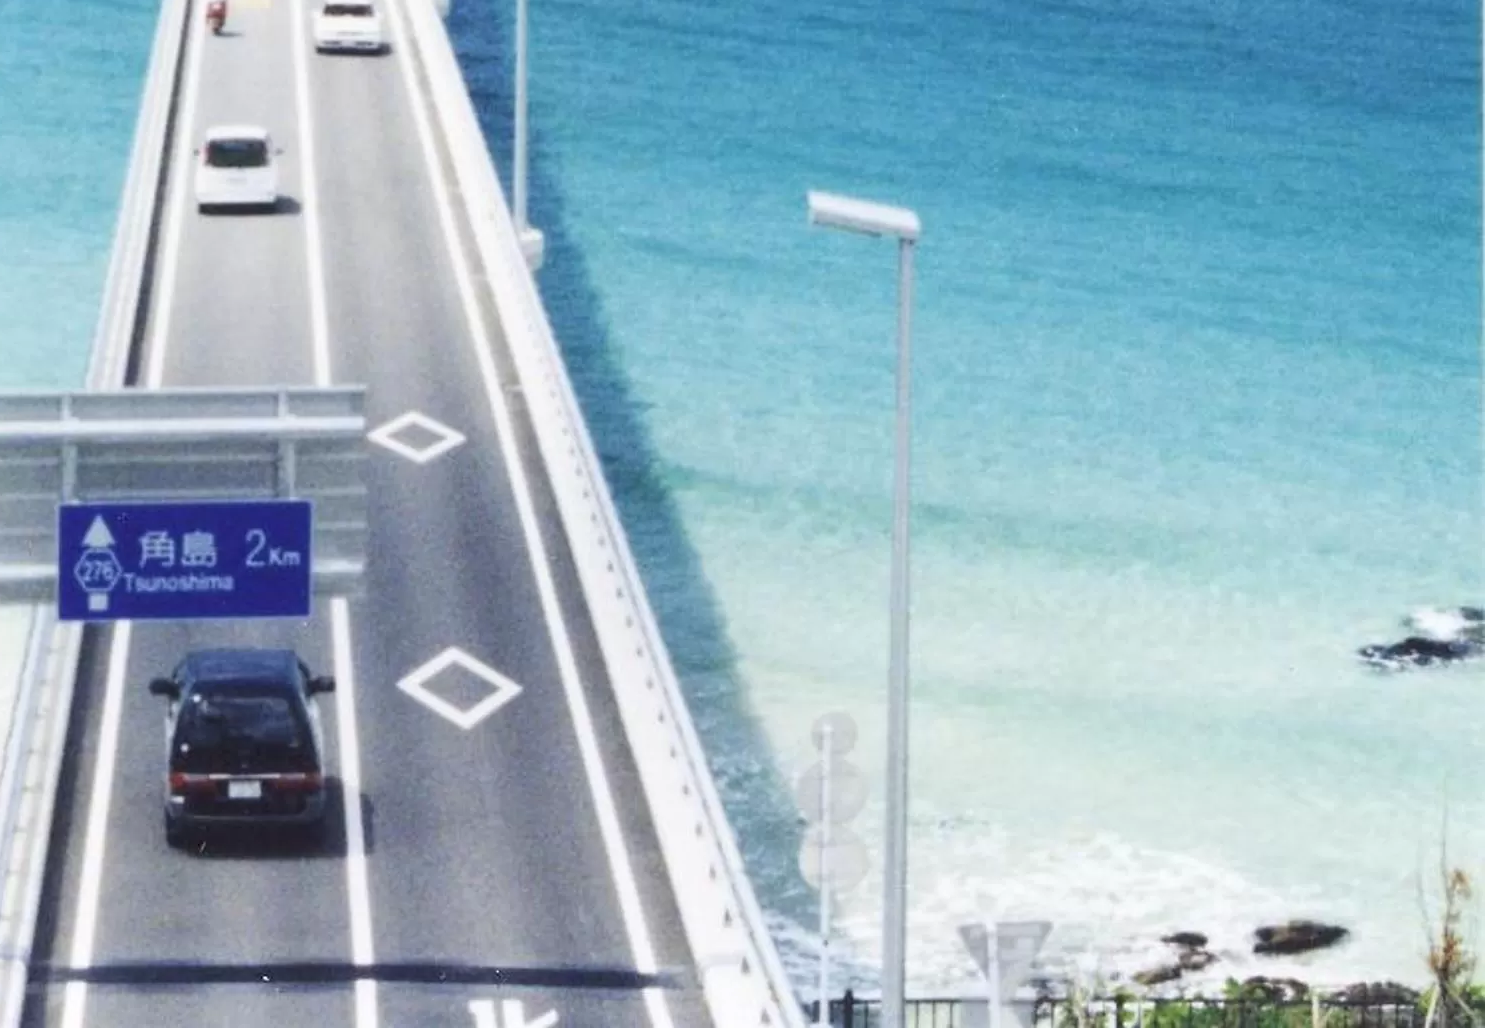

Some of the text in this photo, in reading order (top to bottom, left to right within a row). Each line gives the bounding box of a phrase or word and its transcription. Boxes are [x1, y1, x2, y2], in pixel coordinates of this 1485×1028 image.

[139, 529, 217, 568] 角島
[81, 560, 115, 583] 276
[124, 574, 234, 592] Tsunoshima
